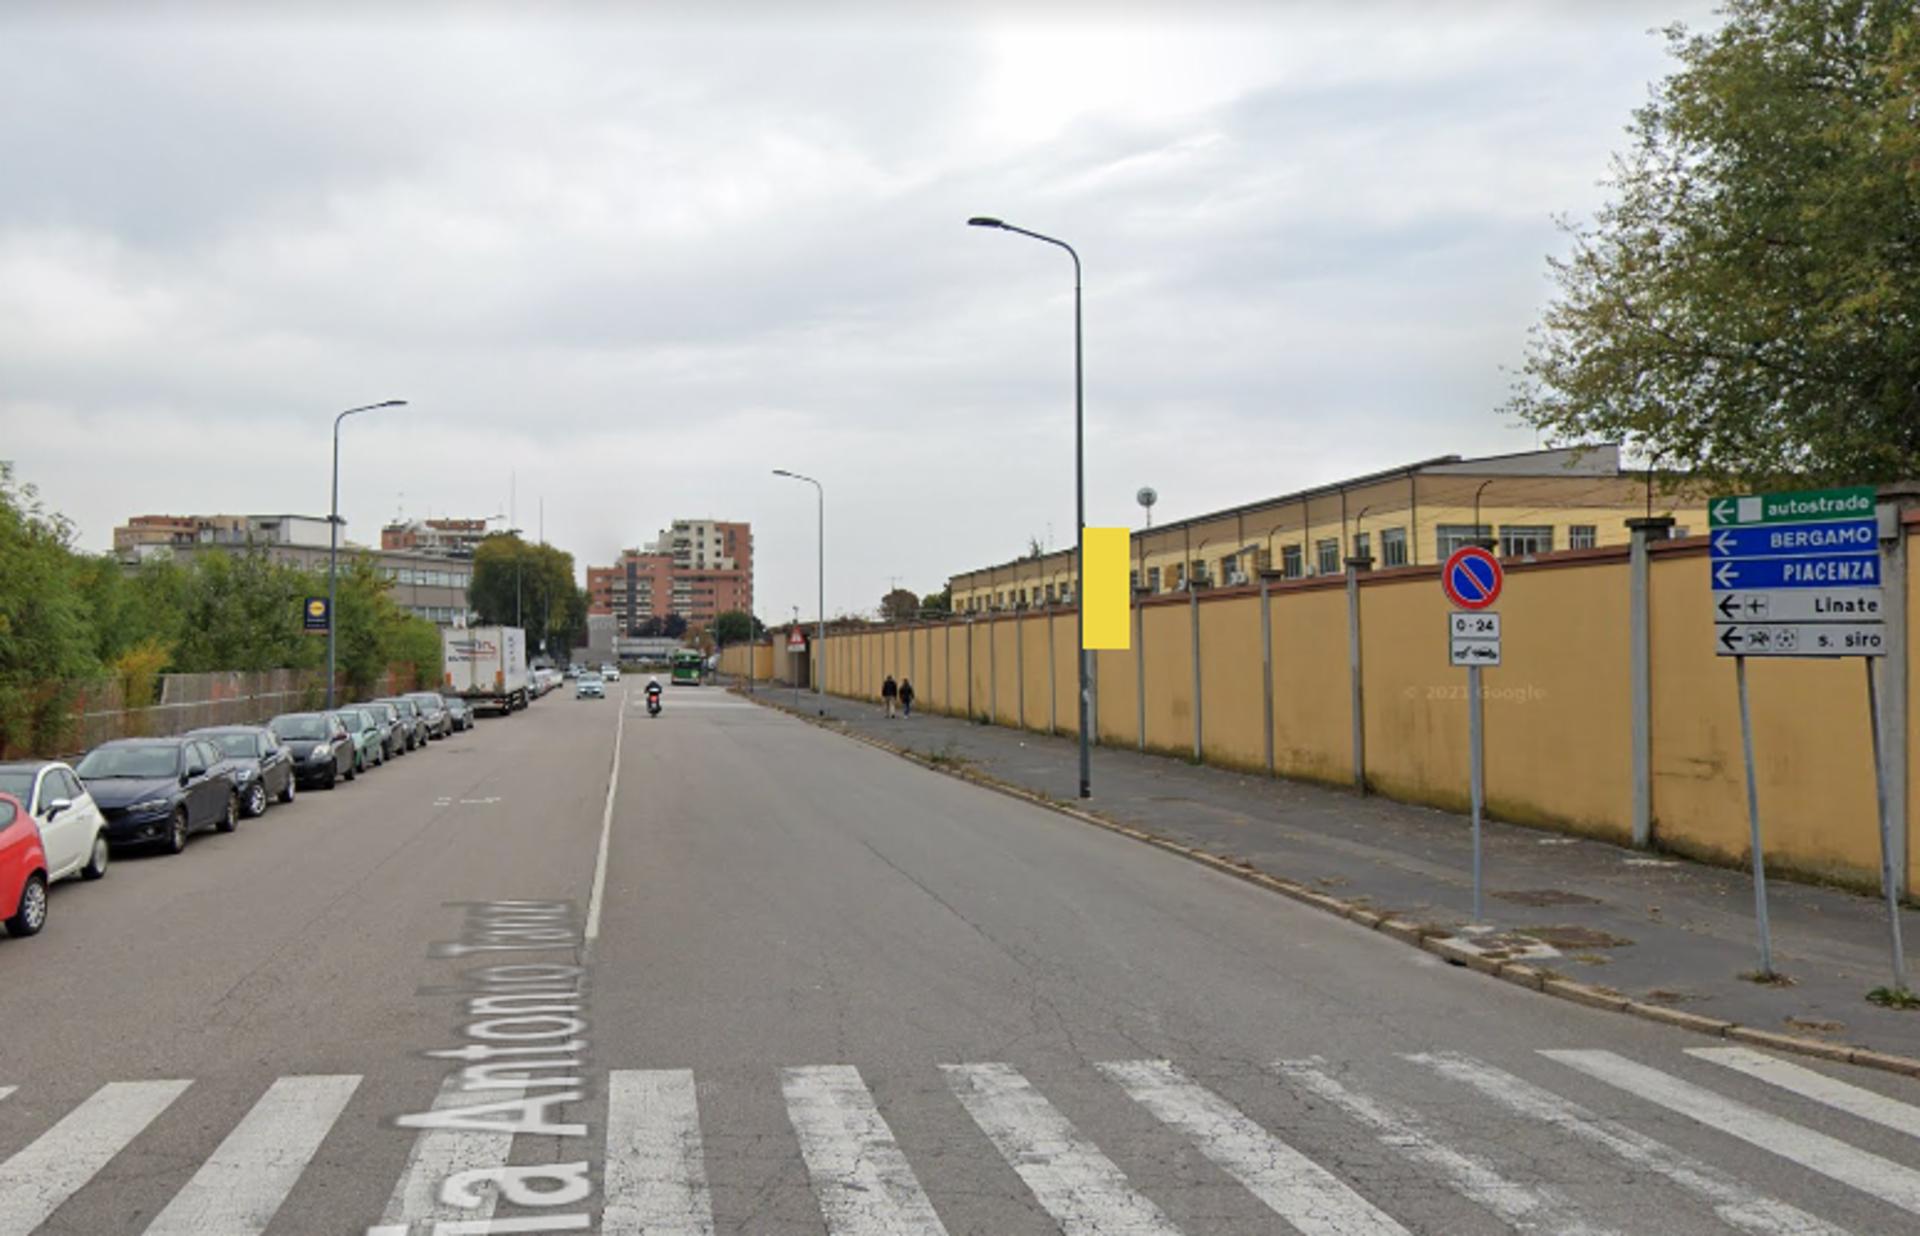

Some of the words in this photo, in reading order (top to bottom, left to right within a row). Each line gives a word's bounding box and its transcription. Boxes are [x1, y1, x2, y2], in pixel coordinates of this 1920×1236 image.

[1768, 494, 1870, 516] autostrade
[1770, 527, 1872, 549] BERGAMO
[1783, 561, 1875, 581] PIACENZA
[1814, 597, 1878, 613] Linate
[1475, 618, 1494, 632] 24
[1818, 634, 1834, 648] s.
[1845, 632, 1881, 648] siro
